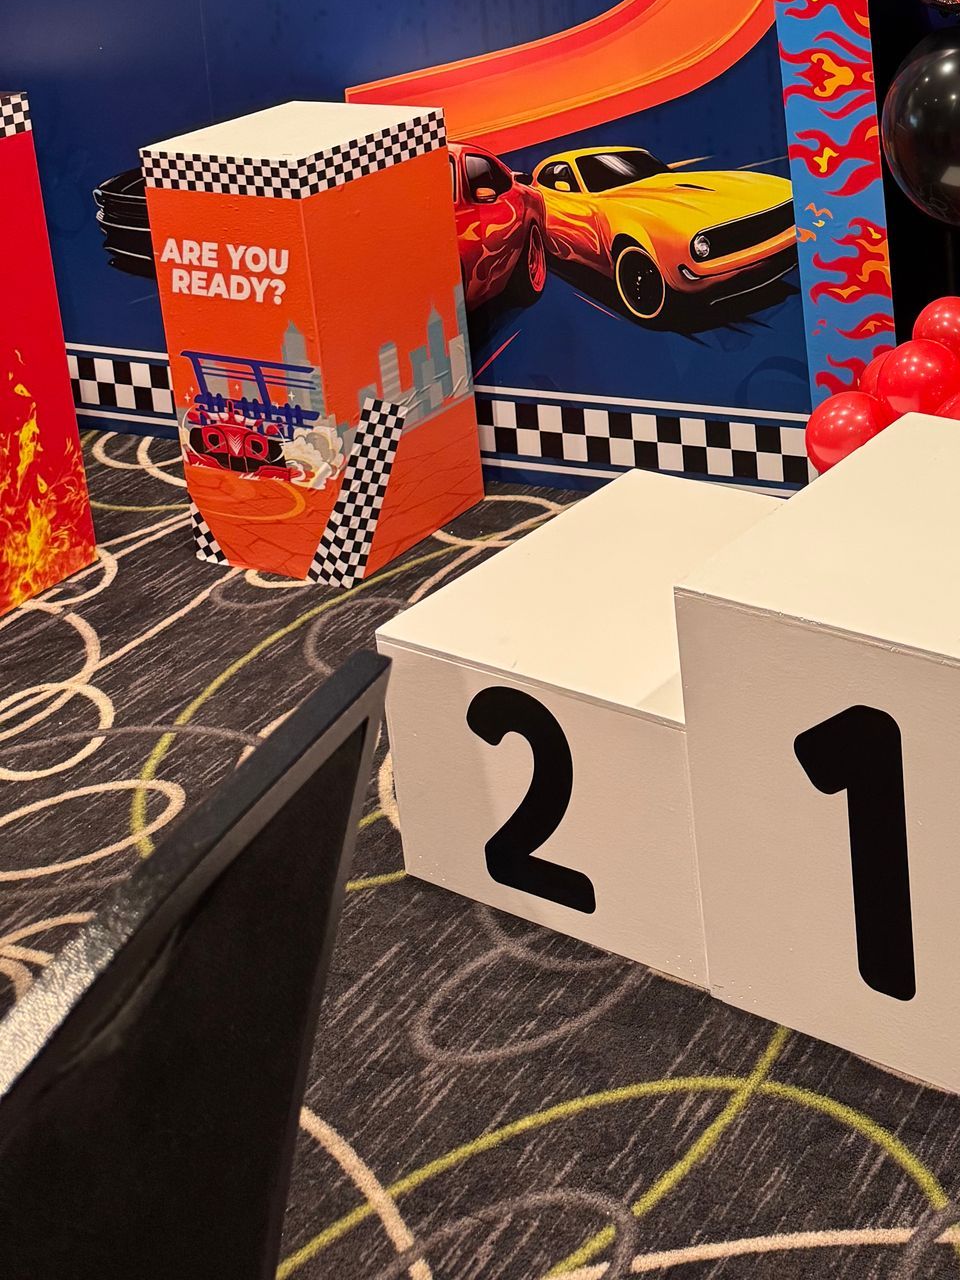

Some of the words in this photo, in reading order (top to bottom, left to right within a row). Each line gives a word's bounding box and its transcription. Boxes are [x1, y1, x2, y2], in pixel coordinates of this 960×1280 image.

[160, 238, 219, 268] ARE
[226, 244, 289, 275] YOU
[172, 268, 287, 305] READY?
[467, 687, 596, 914] 2
[794, 705, 916, 1001] 1
